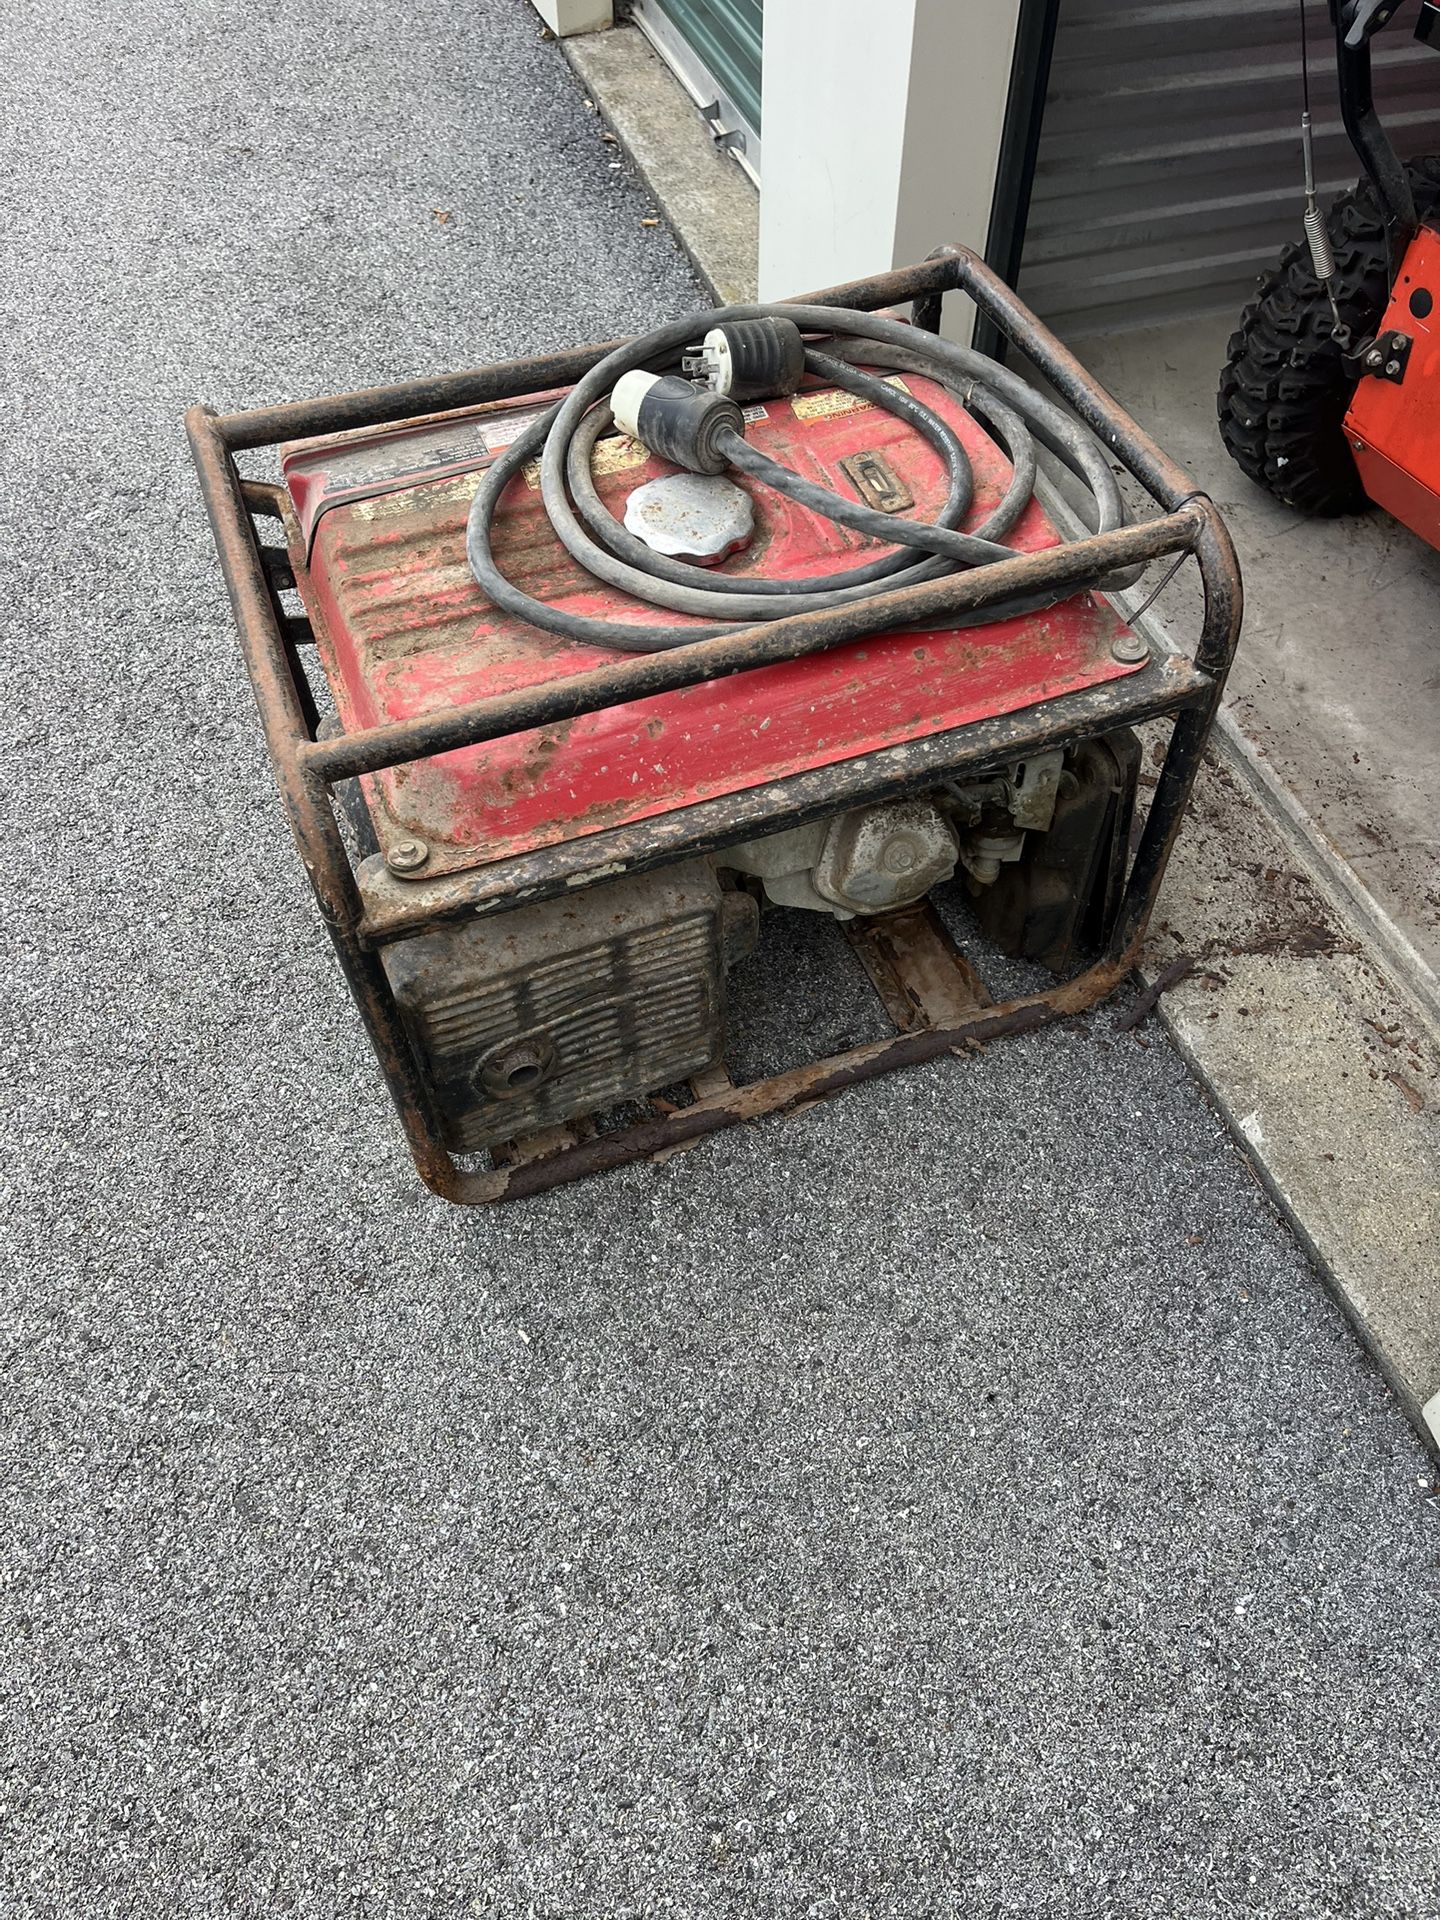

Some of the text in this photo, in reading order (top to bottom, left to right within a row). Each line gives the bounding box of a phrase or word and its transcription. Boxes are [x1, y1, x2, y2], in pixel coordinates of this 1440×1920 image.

[846, 367, 857, 375] USA
[824, 403, 877, 421] WARNING
[880, 384, 897, 397] CAROL
[927, 418, 942, 433] WATER
